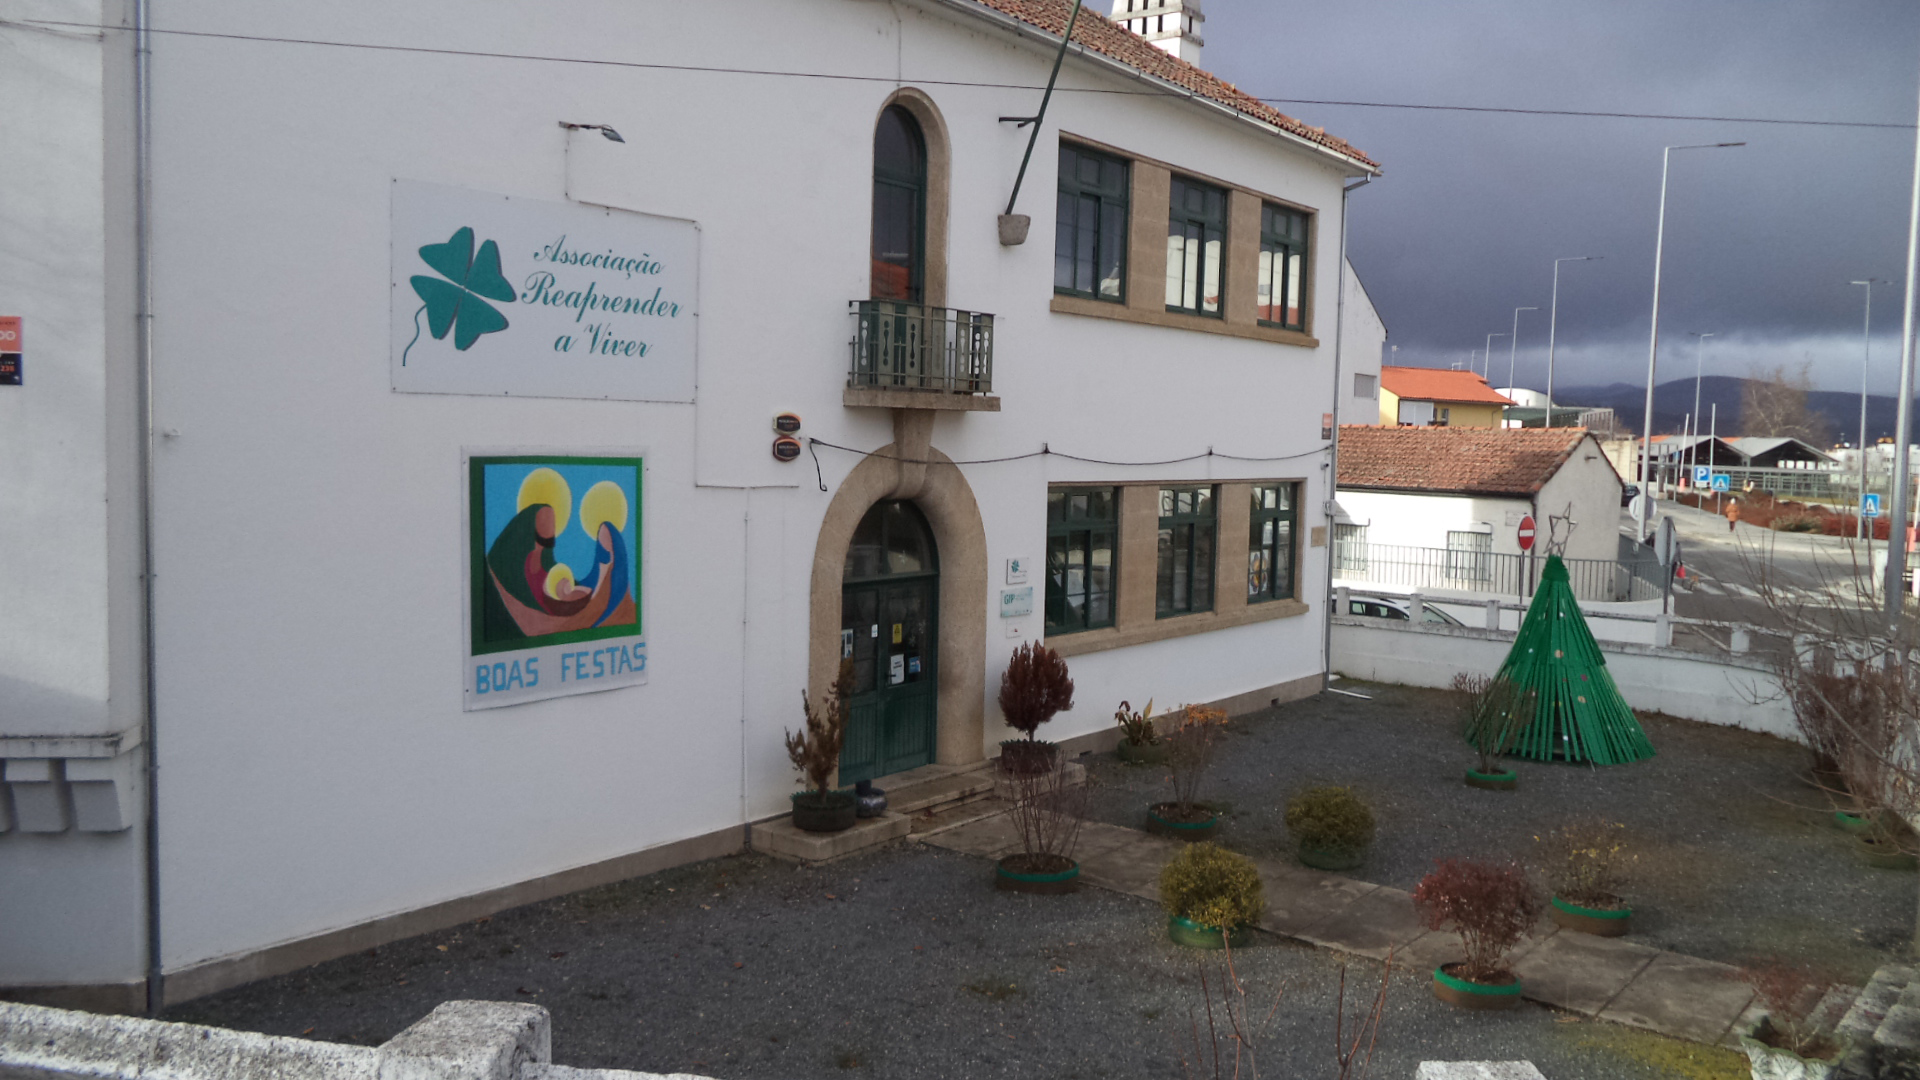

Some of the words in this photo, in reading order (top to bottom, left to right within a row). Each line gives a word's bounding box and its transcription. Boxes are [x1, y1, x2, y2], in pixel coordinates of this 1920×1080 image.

[533, 234, 665, 279] Associação
[521, 271, 682, 322] Reaprender
[554, 333, 577, 353] a
[584, 323, 652, 358] Viver
[1697, 468, 1707, 480] P
[476, 657, 539, 694] BOAS
[561, 642, 647, 682] FESTAS
